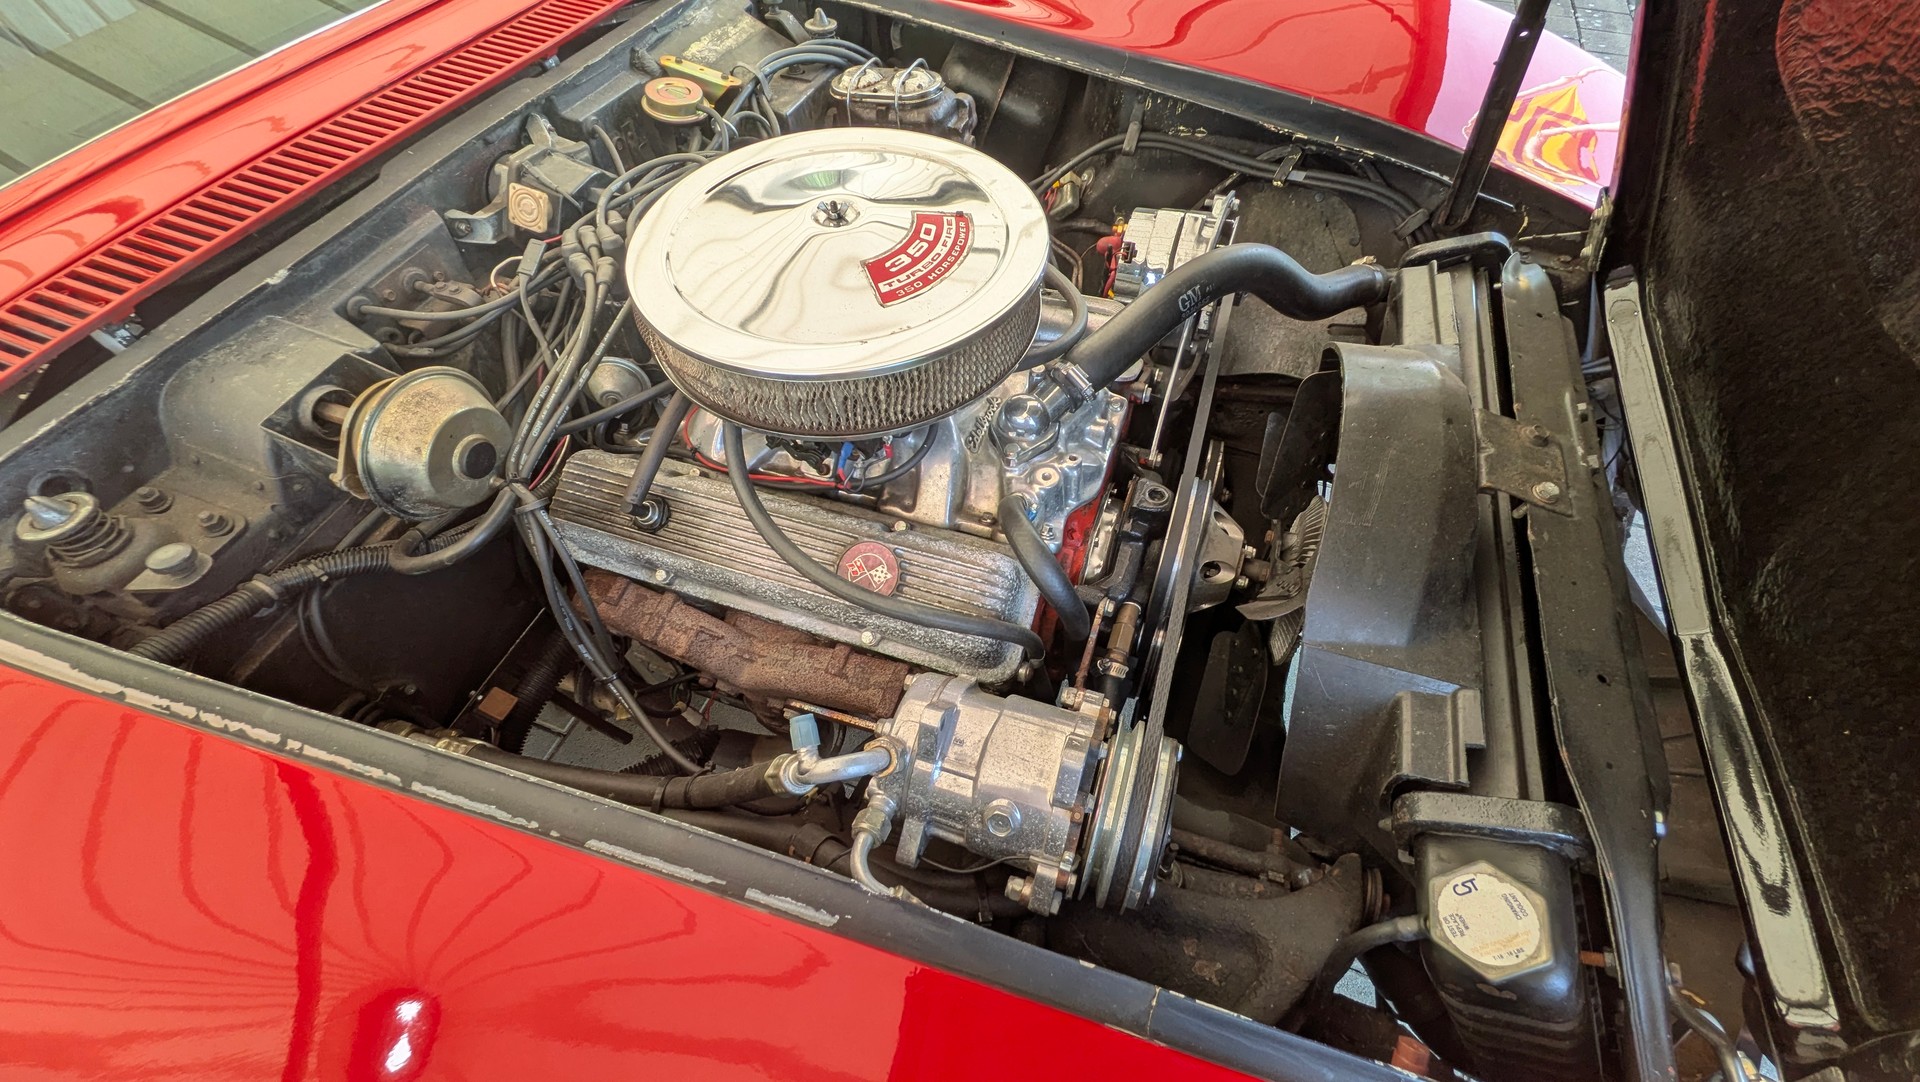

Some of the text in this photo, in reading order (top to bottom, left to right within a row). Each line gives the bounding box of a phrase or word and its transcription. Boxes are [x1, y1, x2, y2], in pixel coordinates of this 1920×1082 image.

[883, 218, 953, 288] TURBO-FIRE
[885, 222, 937, 272] 350
[896, 221, 966, 296] 350 HORSEPOWER
[1178, 284, 1202, 312] GM
[965, 397, 1002, 453] Edelbrock
[1452, 878, 1478, 896] 5
[1501, 893, 1522, 920] CHANGING
[1509, 892, 1529, 917] COOLANT
[1443, 916, 1458, 938] TEST OR
[1449, 912, 1465, 938] REPLACE
